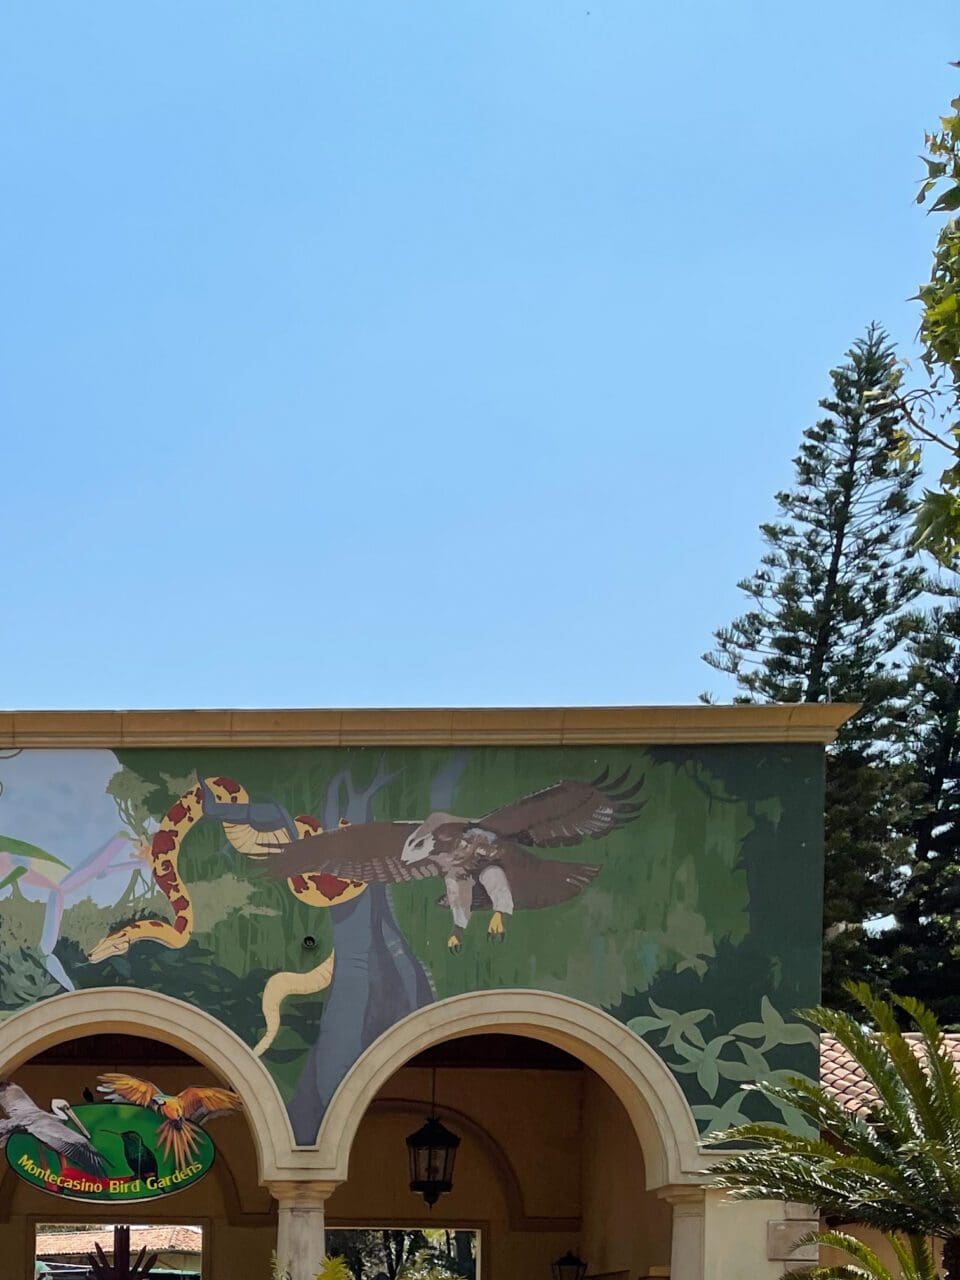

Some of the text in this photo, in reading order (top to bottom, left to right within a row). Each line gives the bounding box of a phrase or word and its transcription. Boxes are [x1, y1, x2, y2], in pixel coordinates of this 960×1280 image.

[18, 1154, 203, 1194] Montecasino Bird Gardens
